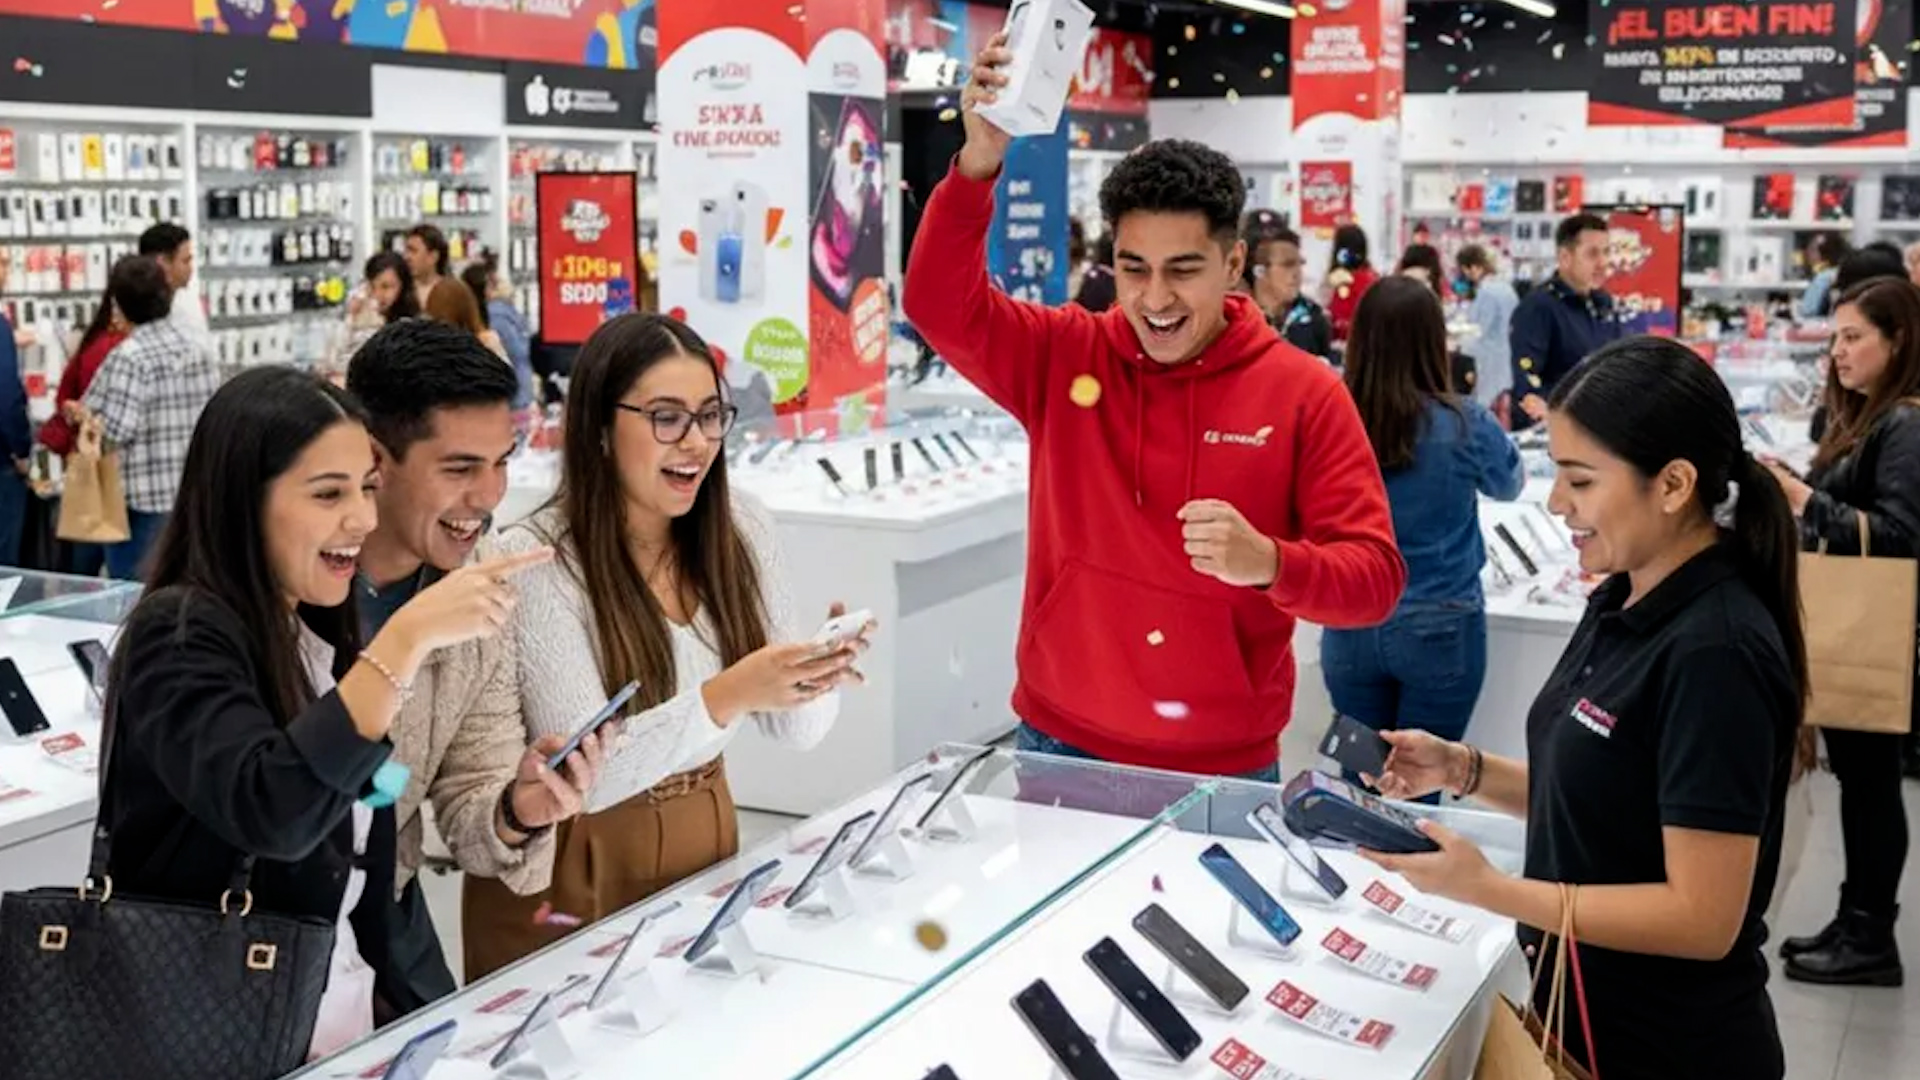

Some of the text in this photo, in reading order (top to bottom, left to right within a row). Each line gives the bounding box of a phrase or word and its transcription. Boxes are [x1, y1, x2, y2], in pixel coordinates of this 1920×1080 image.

[1608, 2, 1836, 45] ¡EL BUEN FIN!
